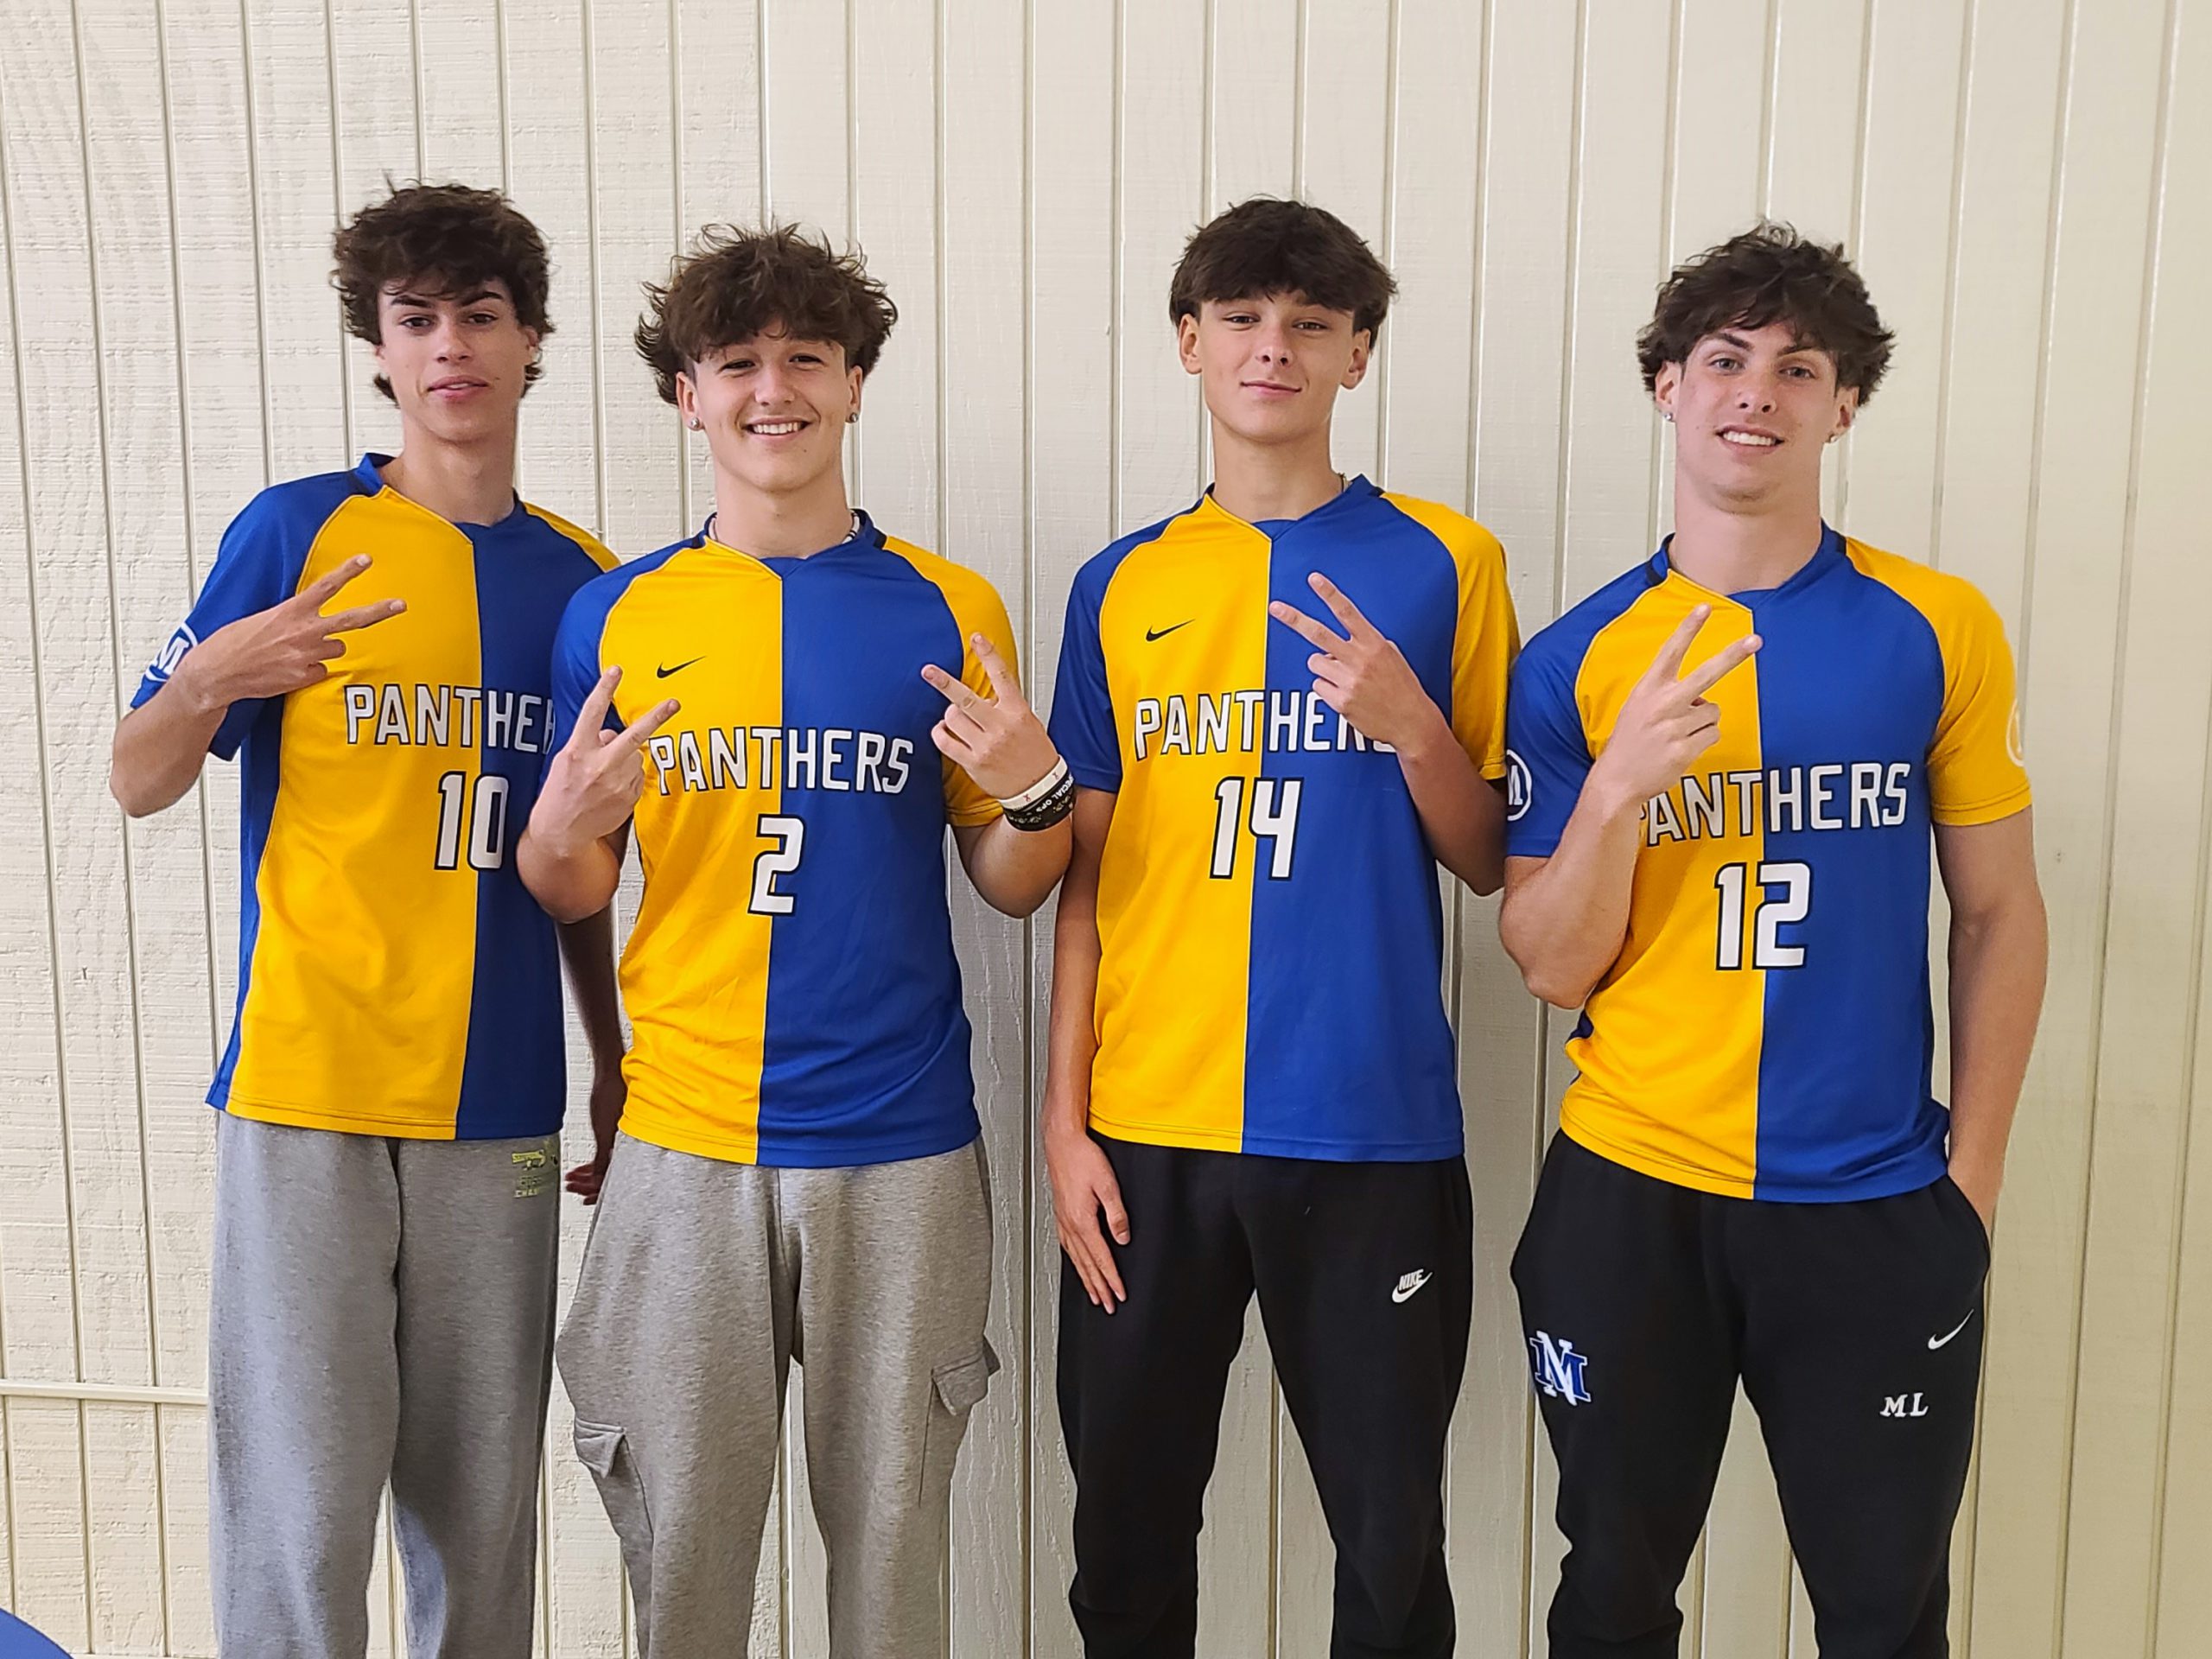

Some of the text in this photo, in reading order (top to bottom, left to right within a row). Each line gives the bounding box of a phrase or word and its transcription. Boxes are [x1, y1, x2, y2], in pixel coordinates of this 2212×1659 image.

[344, 683, 554, 754] PANTHE
[649, 726, 914, 796] PANTHERS
[1134, 689, 1398, 761] PANTHE
[435, 771, 509, 871] 10
[1210, 776, 1304, 880] 14
[1639, 761, 1911, 848] ANTHERS
[747, 814, 805, 916] 2
[1714, 861, 1811, 971] 12
[1398, 1268, 1424, 1291] NIKE
